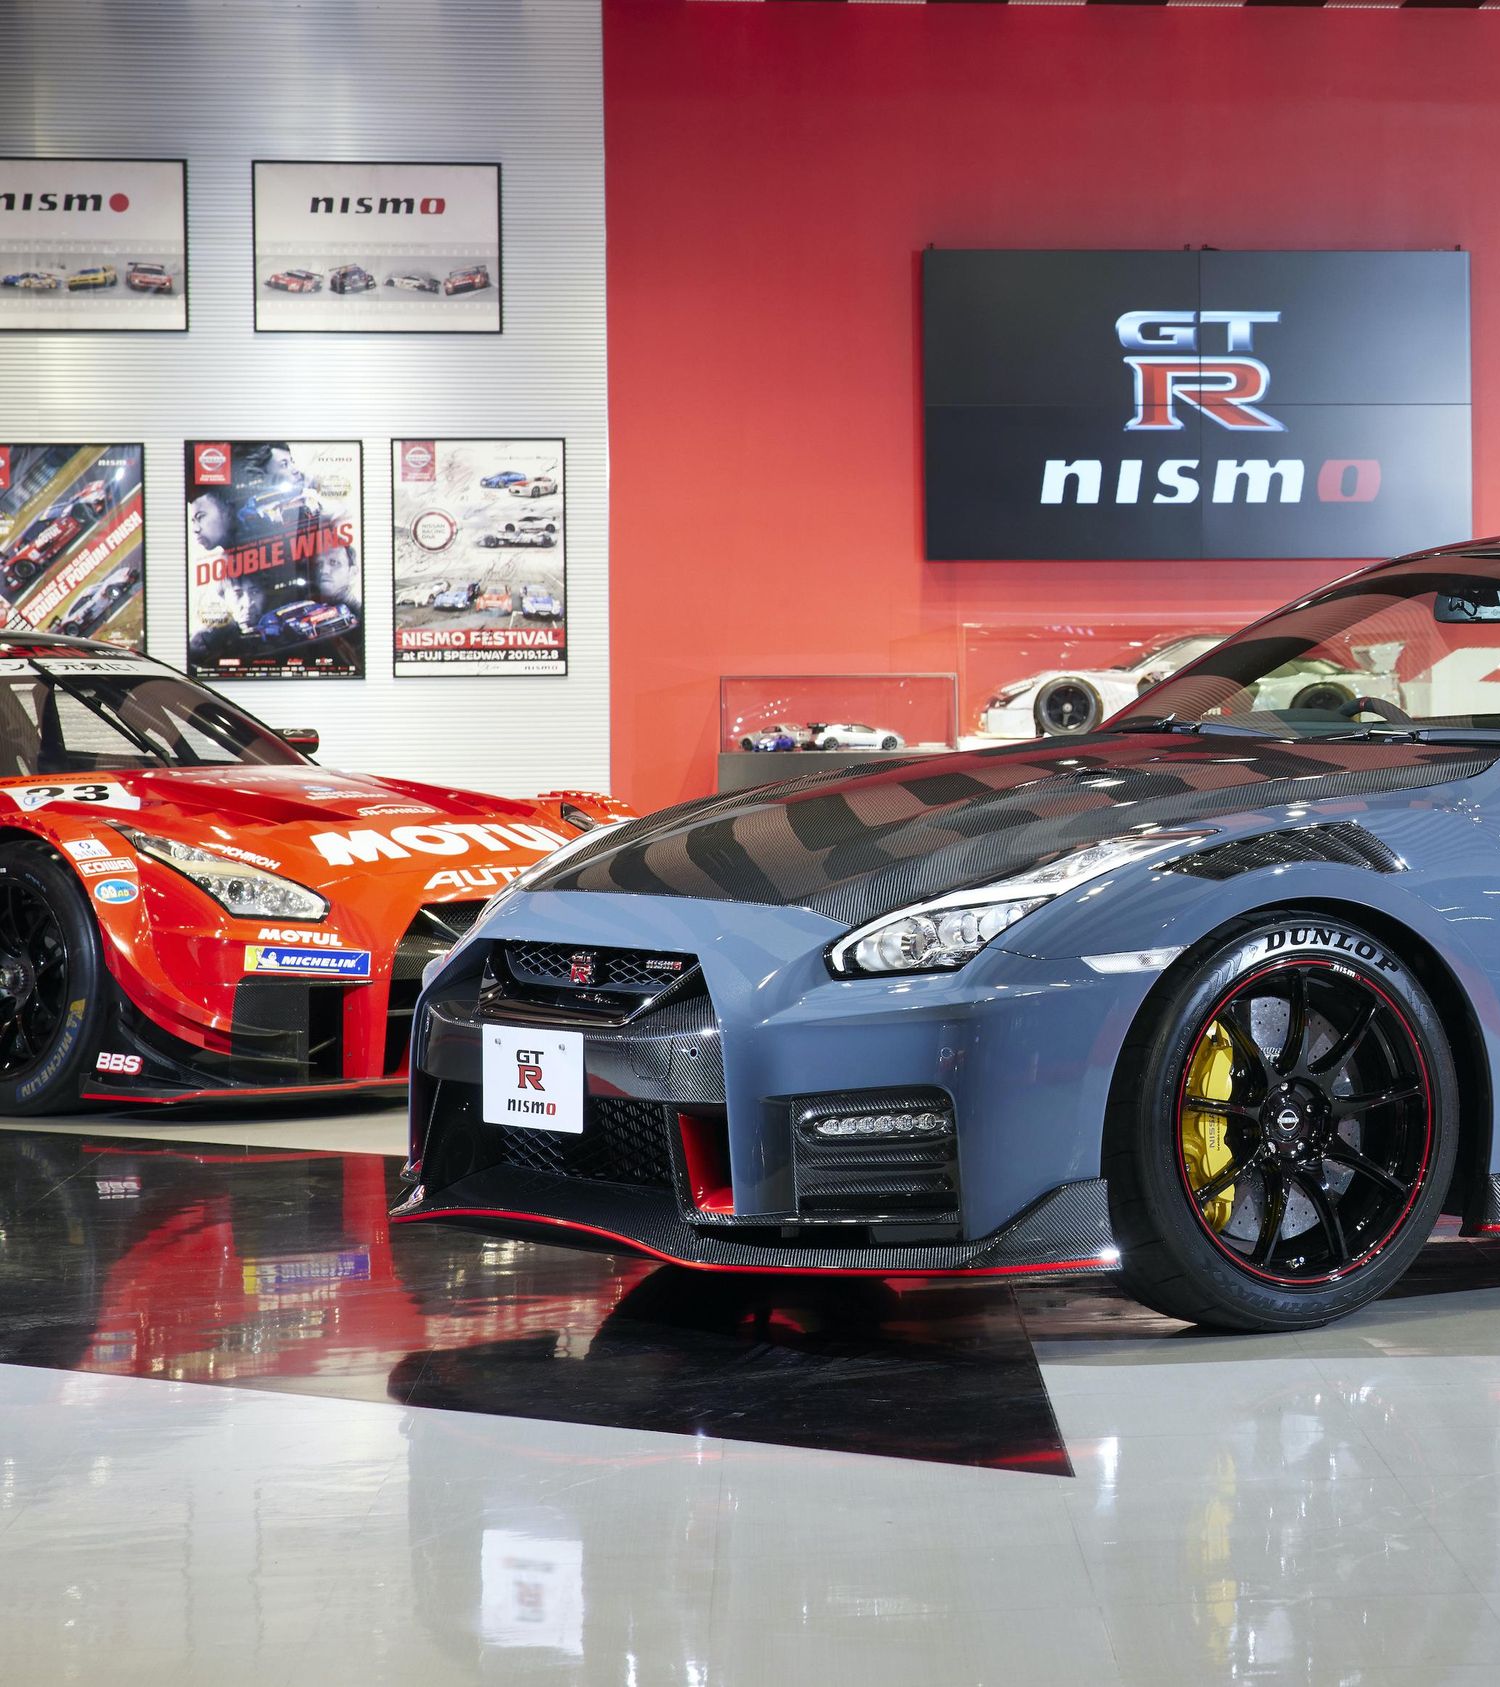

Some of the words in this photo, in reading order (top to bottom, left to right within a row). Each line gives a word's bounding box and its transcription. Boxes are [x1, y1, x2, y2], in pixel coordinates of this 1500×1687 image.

[310, 196, 445, 215] nismo
[1115, 310, 1282, 353] GT
[1123, 356, 1289, 432] R
[1040, 459, 1382, 504] nismo
[196, 540, 285, 587] DOUBLE
[290, 522, 354, 562] WINS
[27, 579, 72, 627] DOUBLE
[66, 541, 112, 589] PODIUM
[105, 510, 143, 551] FINISH
[402, 631, 465, 647] NISMO
[470, 630, 559, 646] FESTIVAL
[402, 651, 416, 661] at
[417, 652, 442, 661] FUJI
[444, 651, 506, 661] SPEEDWAY
[508, 650, 559, 660] 2019.12.8
[26, 784, 110, 802] 23
[424, 865, 530, 890] AUT
[257, 927, 343, 947] MOTUL
[281, 955, 356, 969] MICHELIN
[1264, 927, 1400, 974] DUNLOP
[21, 1031, 74, 1098] MICHELIN
[96, 1052, 143, 1074] BBS
[516, 1049, 545, 1065] GT
[517, 1064, 546, 1092] R
[507, 1098, 557, 1116] nismo
